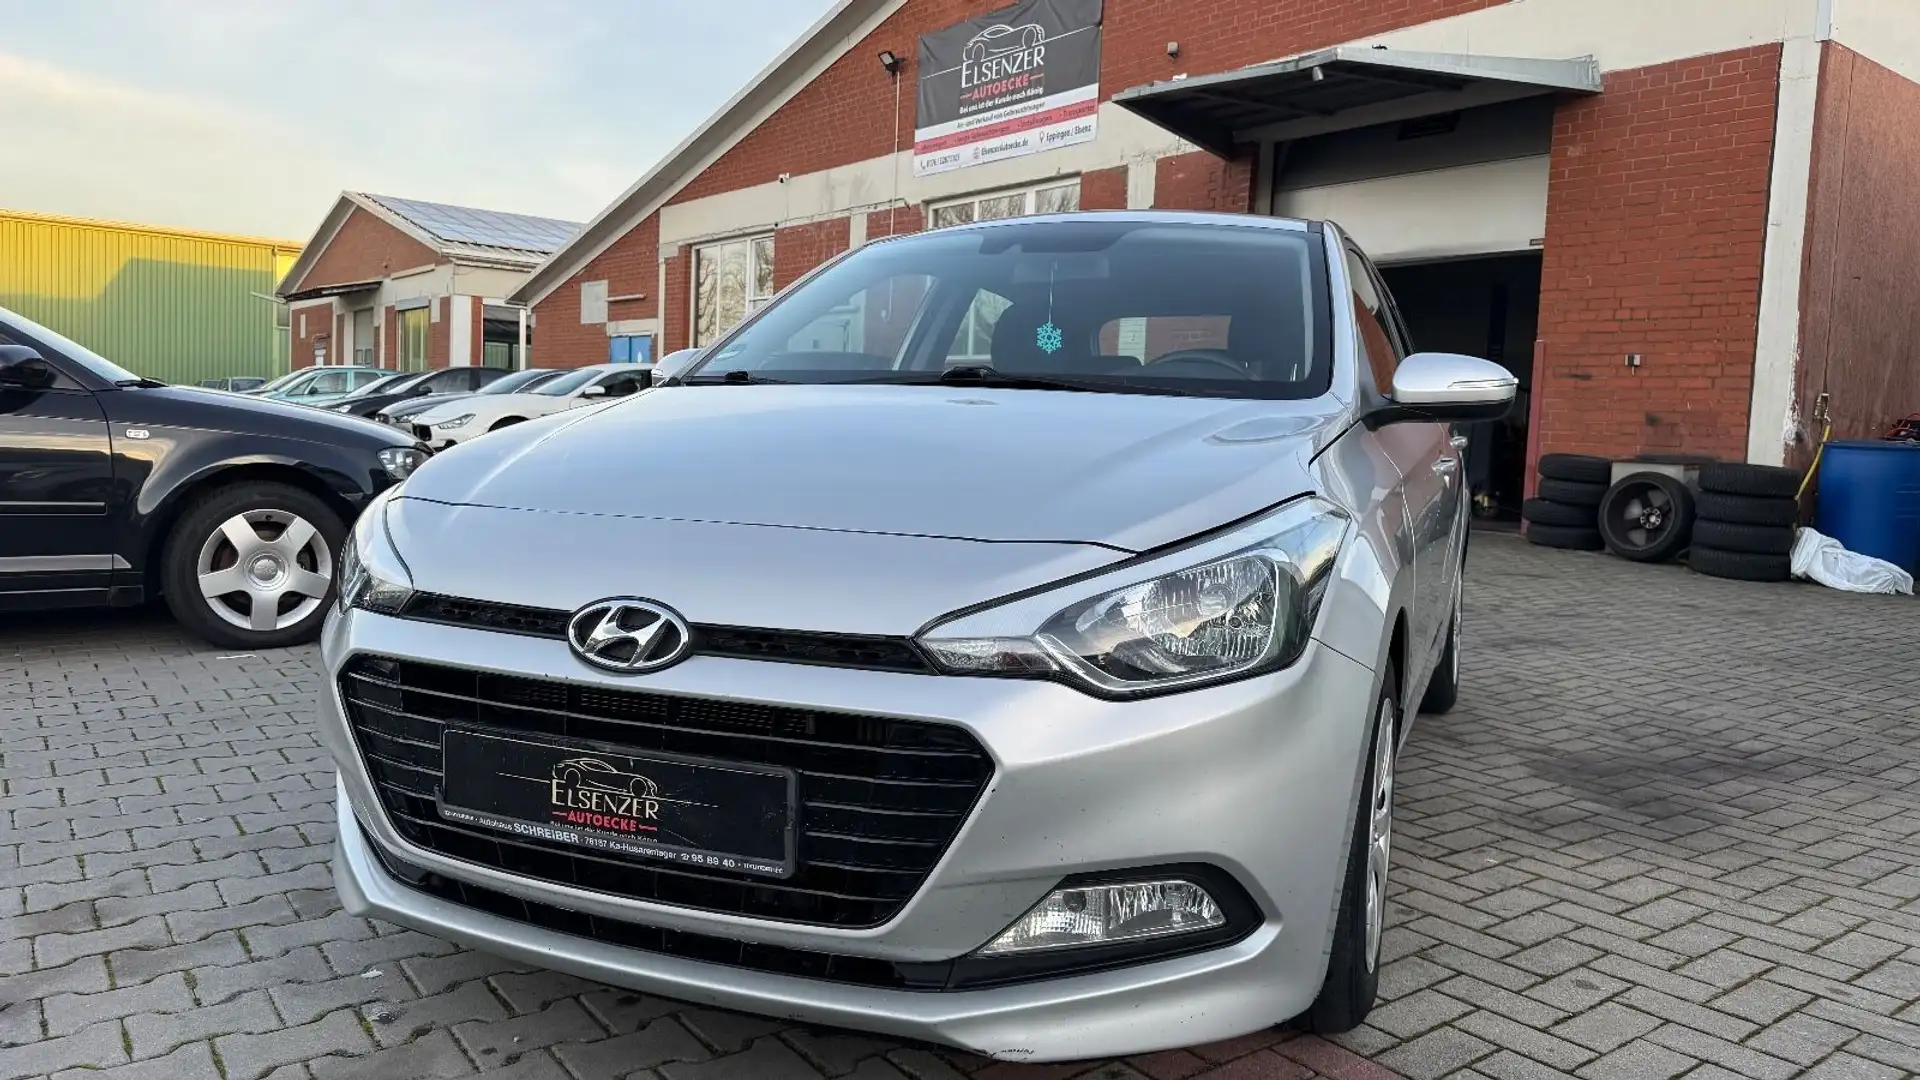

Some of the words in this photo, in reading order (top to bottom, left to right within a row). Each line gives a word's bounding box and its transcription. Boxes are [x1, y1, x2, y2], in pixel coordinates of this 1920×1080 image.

[962, 46, 1045, 88] ELSENZER
[972, 73, 1029, 100] AUTOECKE
[552, 778, 658, 820] ELSENZER
[568, 810, 637, 831] AUTOECKE
[513, 823, 579, 843] SCHREIBER
[722, 858, 735, 868] 40
